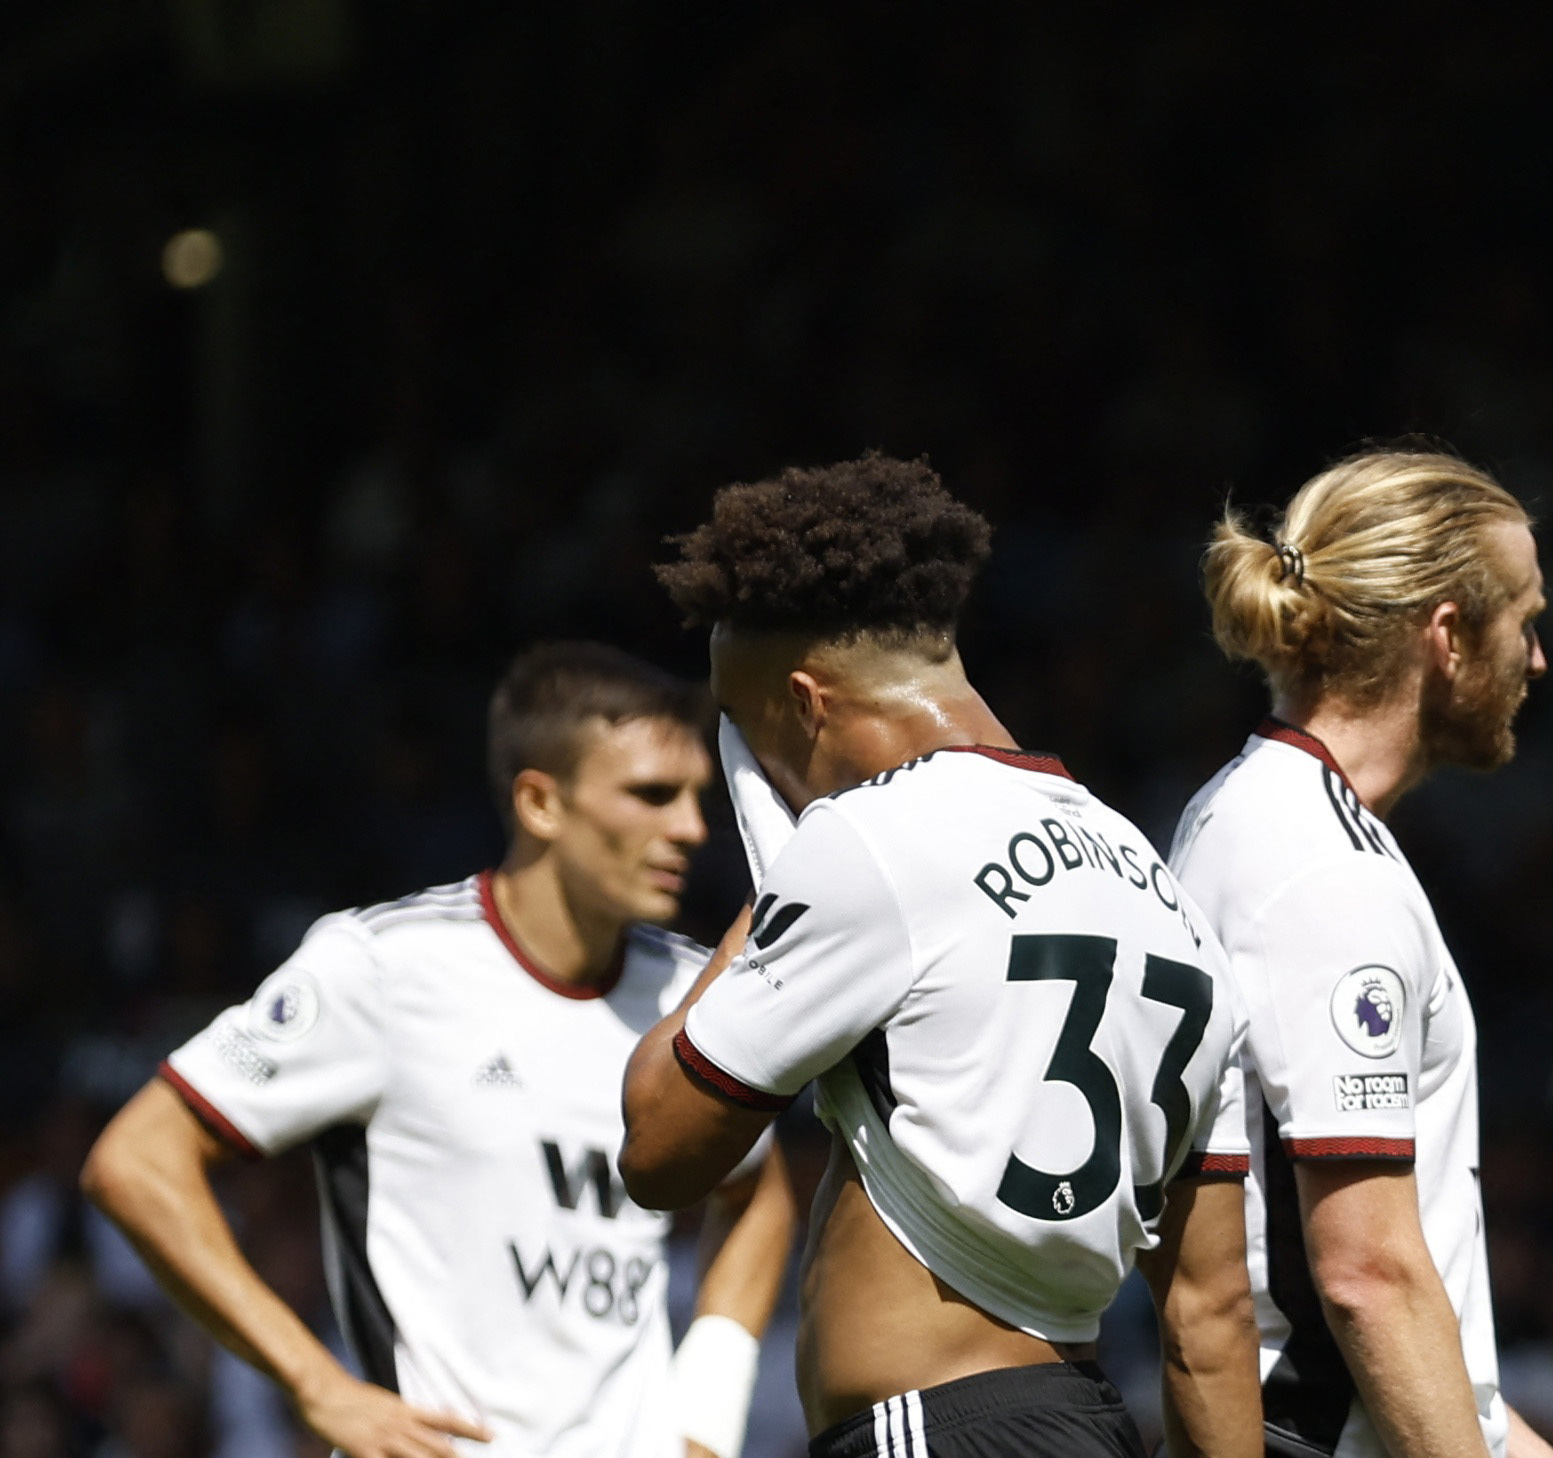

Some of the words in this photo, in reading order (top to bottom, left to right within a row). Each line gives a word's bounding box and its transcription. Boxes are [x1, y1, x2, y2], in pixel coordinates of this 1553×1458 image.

[743, 950, 784, 991] OBILE
[996, 934, 1213, 1222] 33
[1335, 1075, 1364, 1096] No
[1364, 1075, 1405, 1093] room
[508, 1242, 652, 1327] W88
